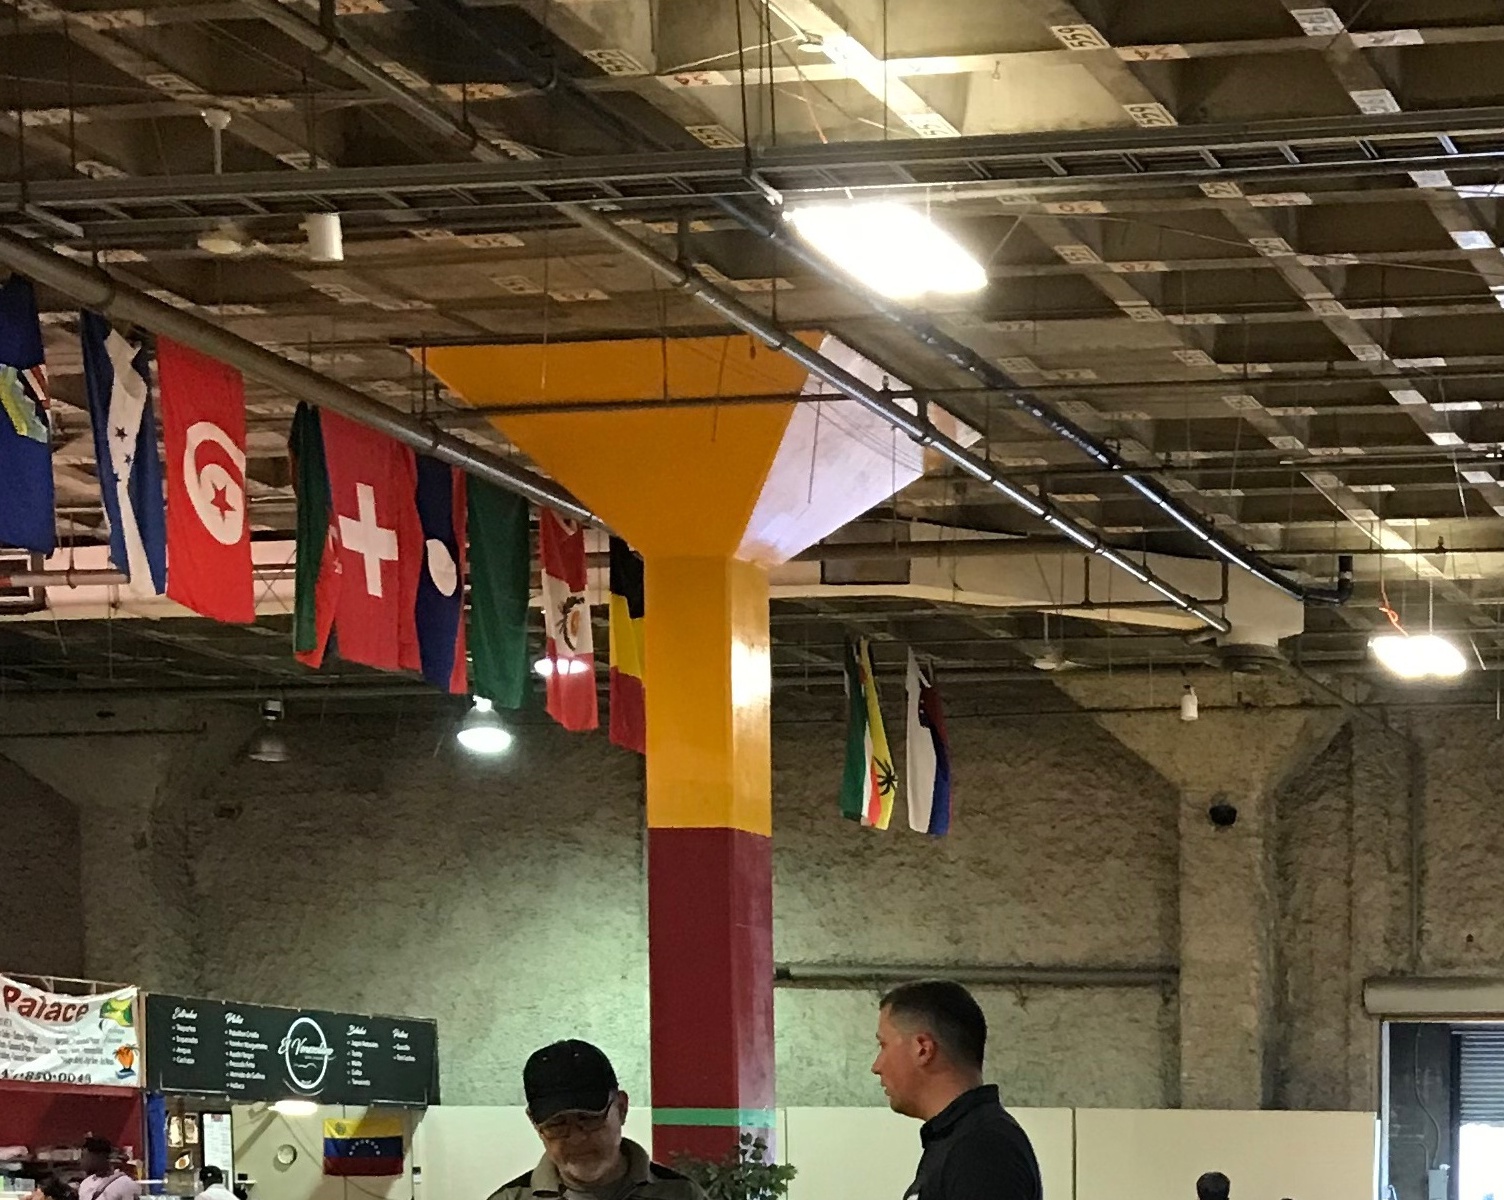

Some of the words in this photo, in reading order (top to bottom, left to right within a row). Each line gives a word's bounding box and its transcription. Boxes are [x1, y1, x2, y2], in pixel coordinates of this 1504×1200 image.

[1057, 27, 1095, 49] 559
[1130, 106, 1162, 126] 559
[3, 985, 89, 1022] Palace
